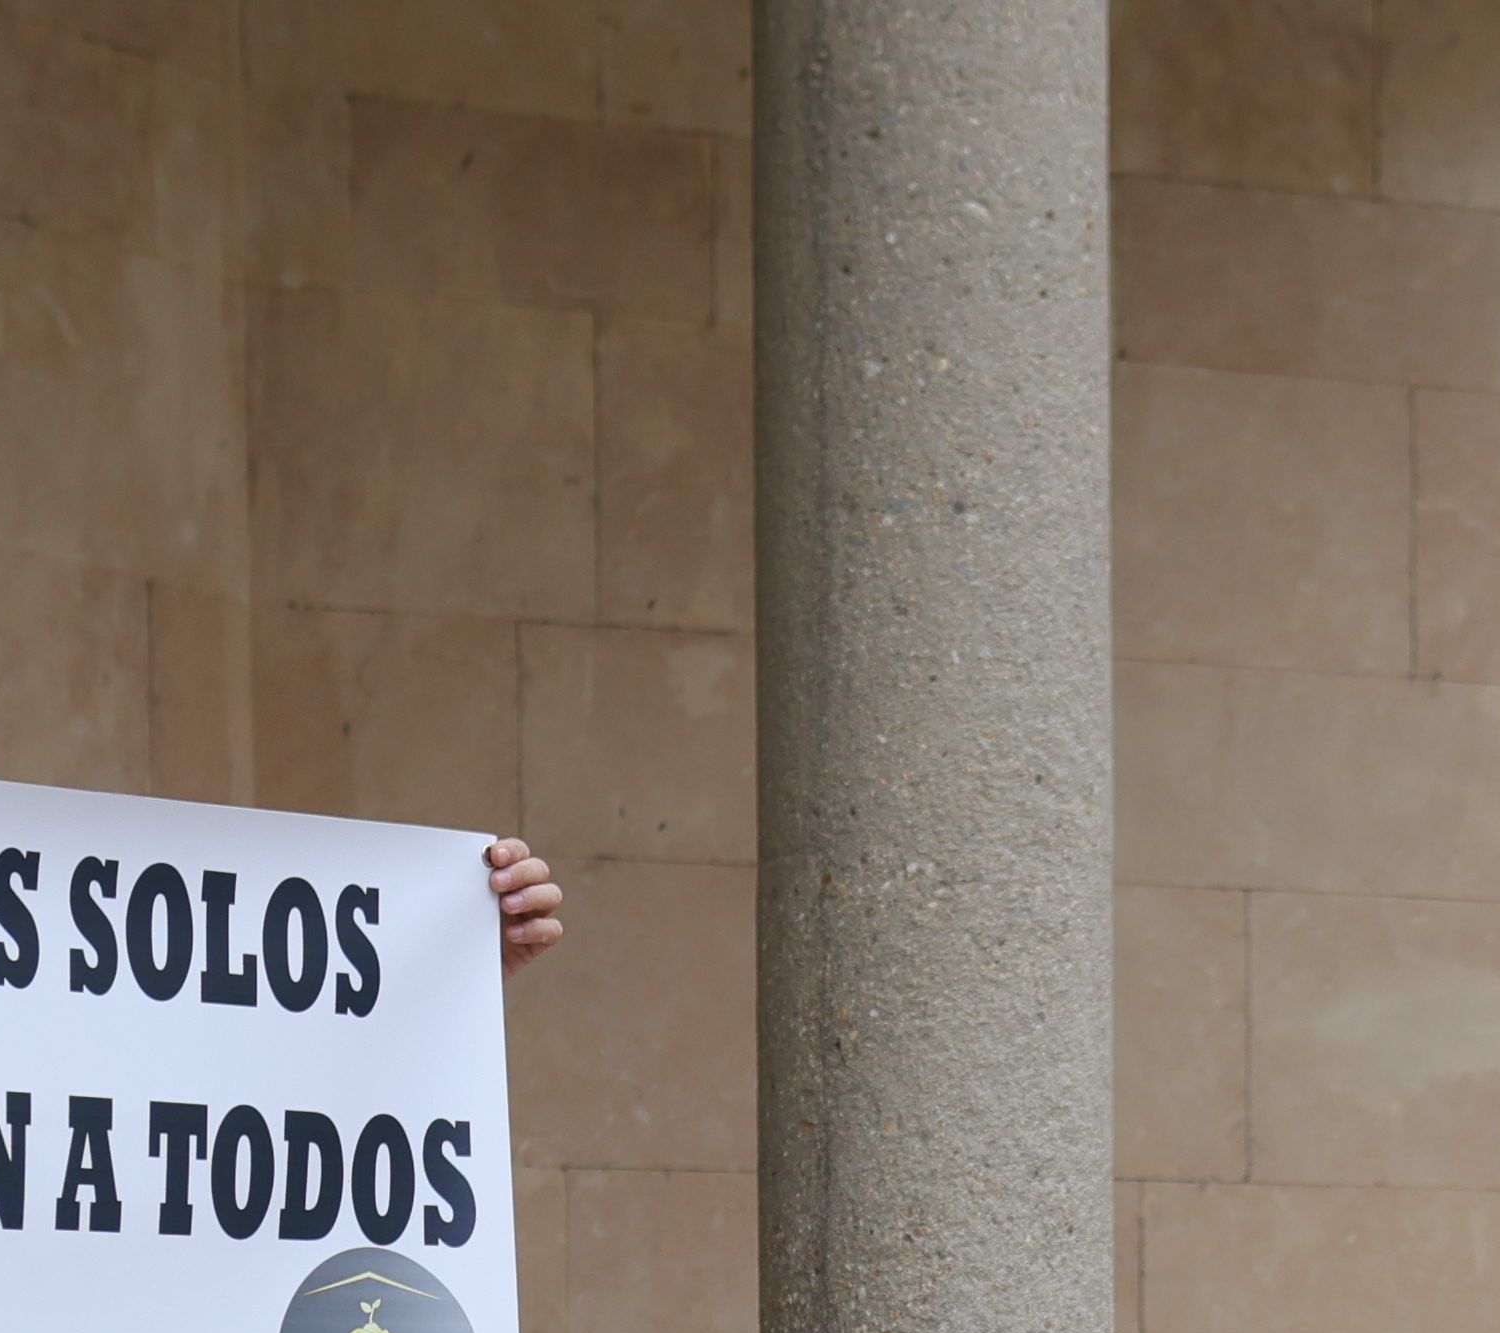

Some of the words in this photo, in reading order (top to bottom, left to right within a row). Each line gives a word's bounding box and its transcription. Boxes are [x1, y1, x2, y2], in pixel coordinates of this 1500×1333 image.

[69, 855, 381, 1017] SOLOS
[55, 1095, 122, 1232] A
[148, 1100, 477, 1248] TODOS
